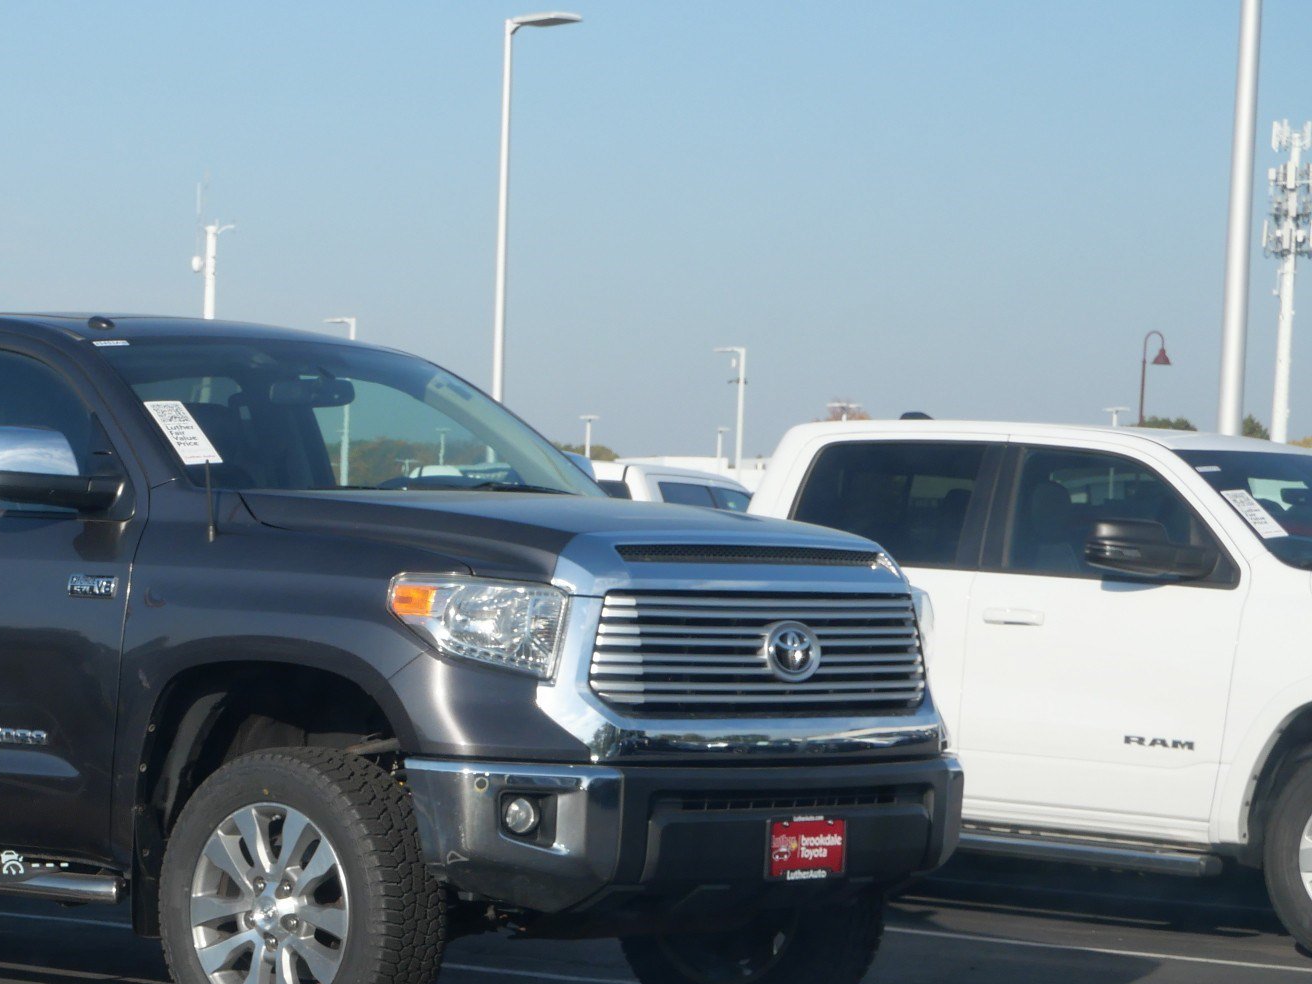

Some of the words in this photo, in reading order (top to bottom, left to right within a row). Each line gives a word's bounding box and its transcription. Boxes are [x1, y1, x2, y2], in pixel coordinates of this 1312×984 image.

[1124, 735, 1195, 751] RAM
[801, 834, 842, 846] brookdale
[800, 846, 828, 860] Toyota
[786, 869, 827, 880] LutherAuto
